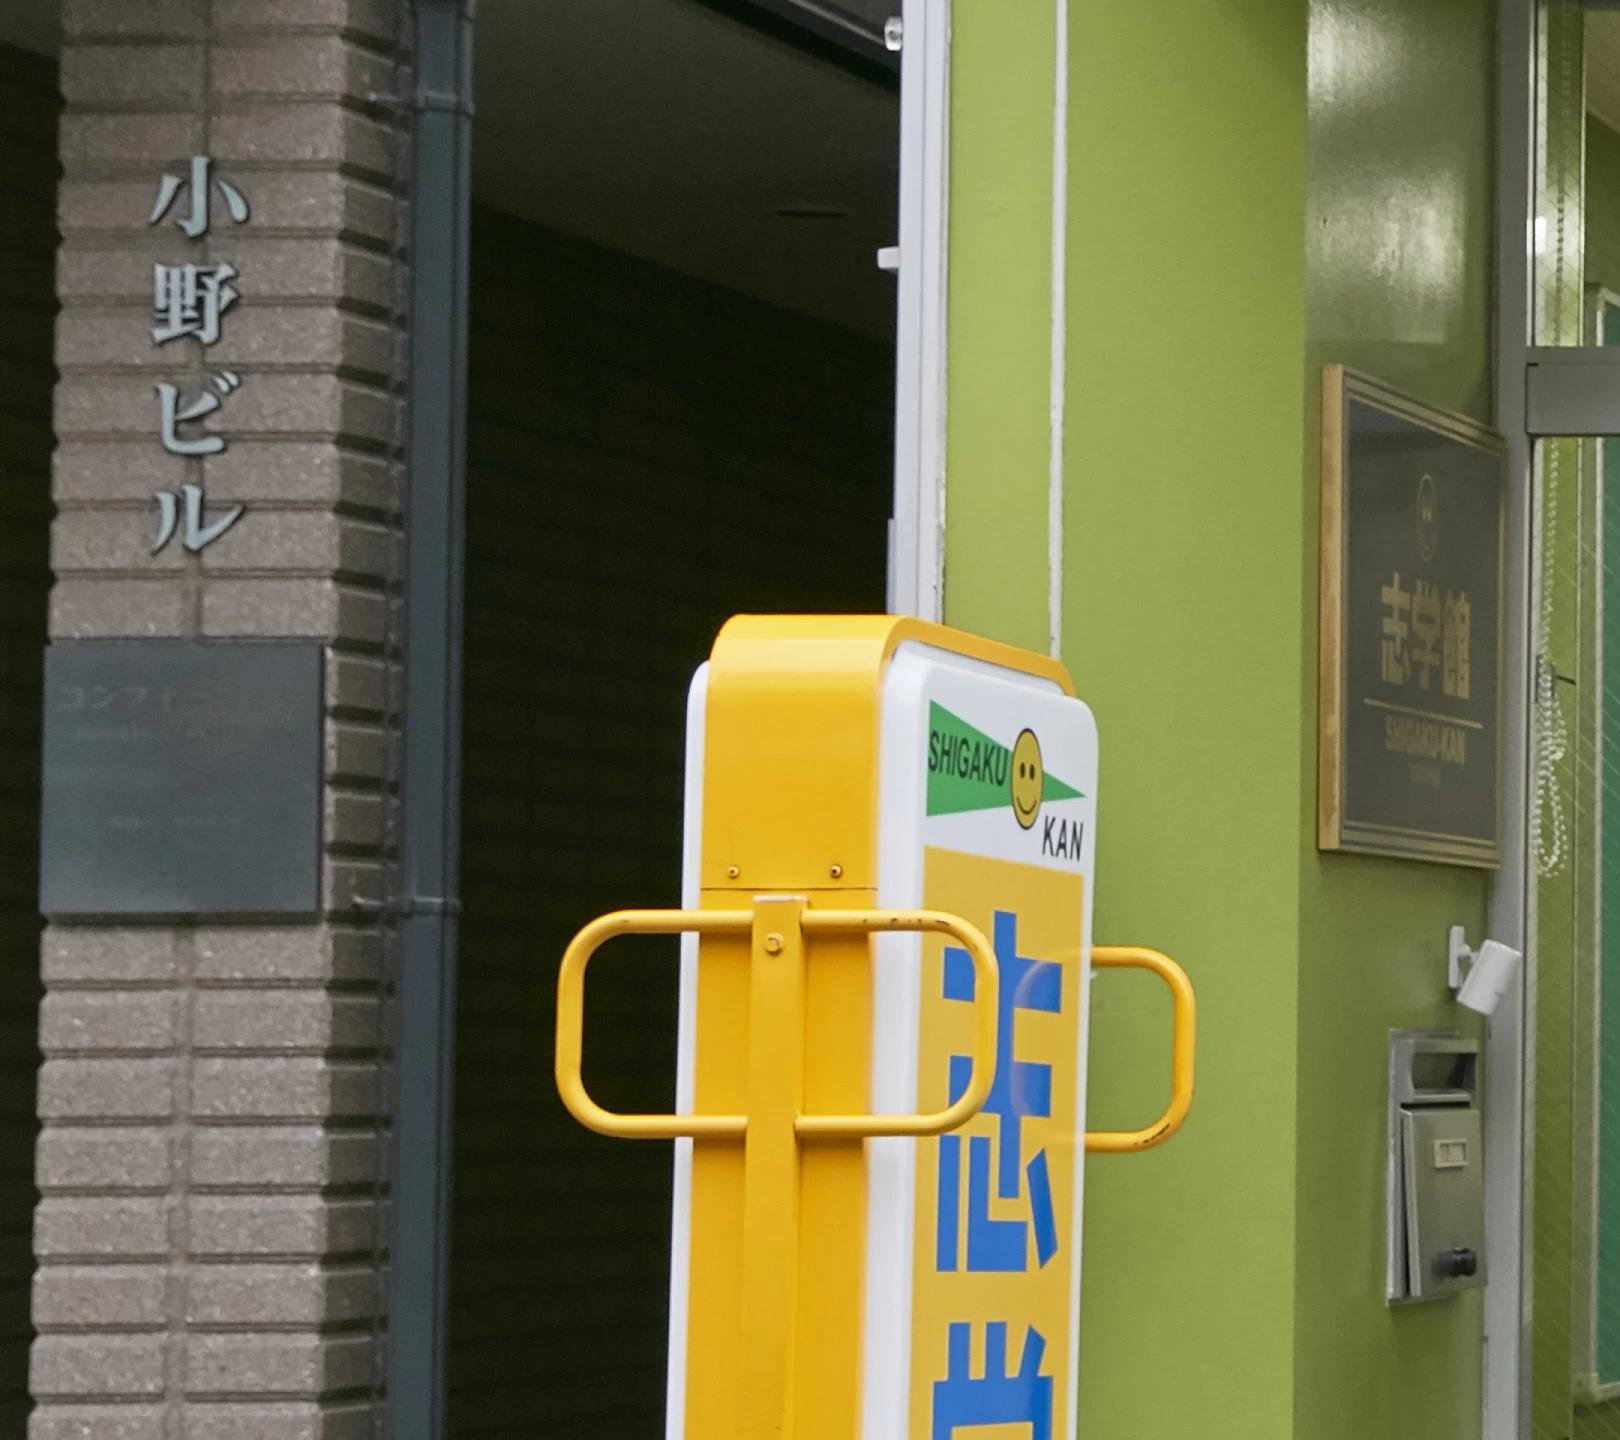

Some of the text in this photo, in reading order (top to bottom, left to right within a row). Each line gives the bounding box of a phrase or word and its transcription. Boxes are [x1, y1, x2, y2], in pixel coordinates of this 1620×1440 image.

[149, 155, 249, 555] 小野ビル
[1380, 572, 1472, 698] 志学館
[928, 730, 1084, 862] SHIGAKU KAN
